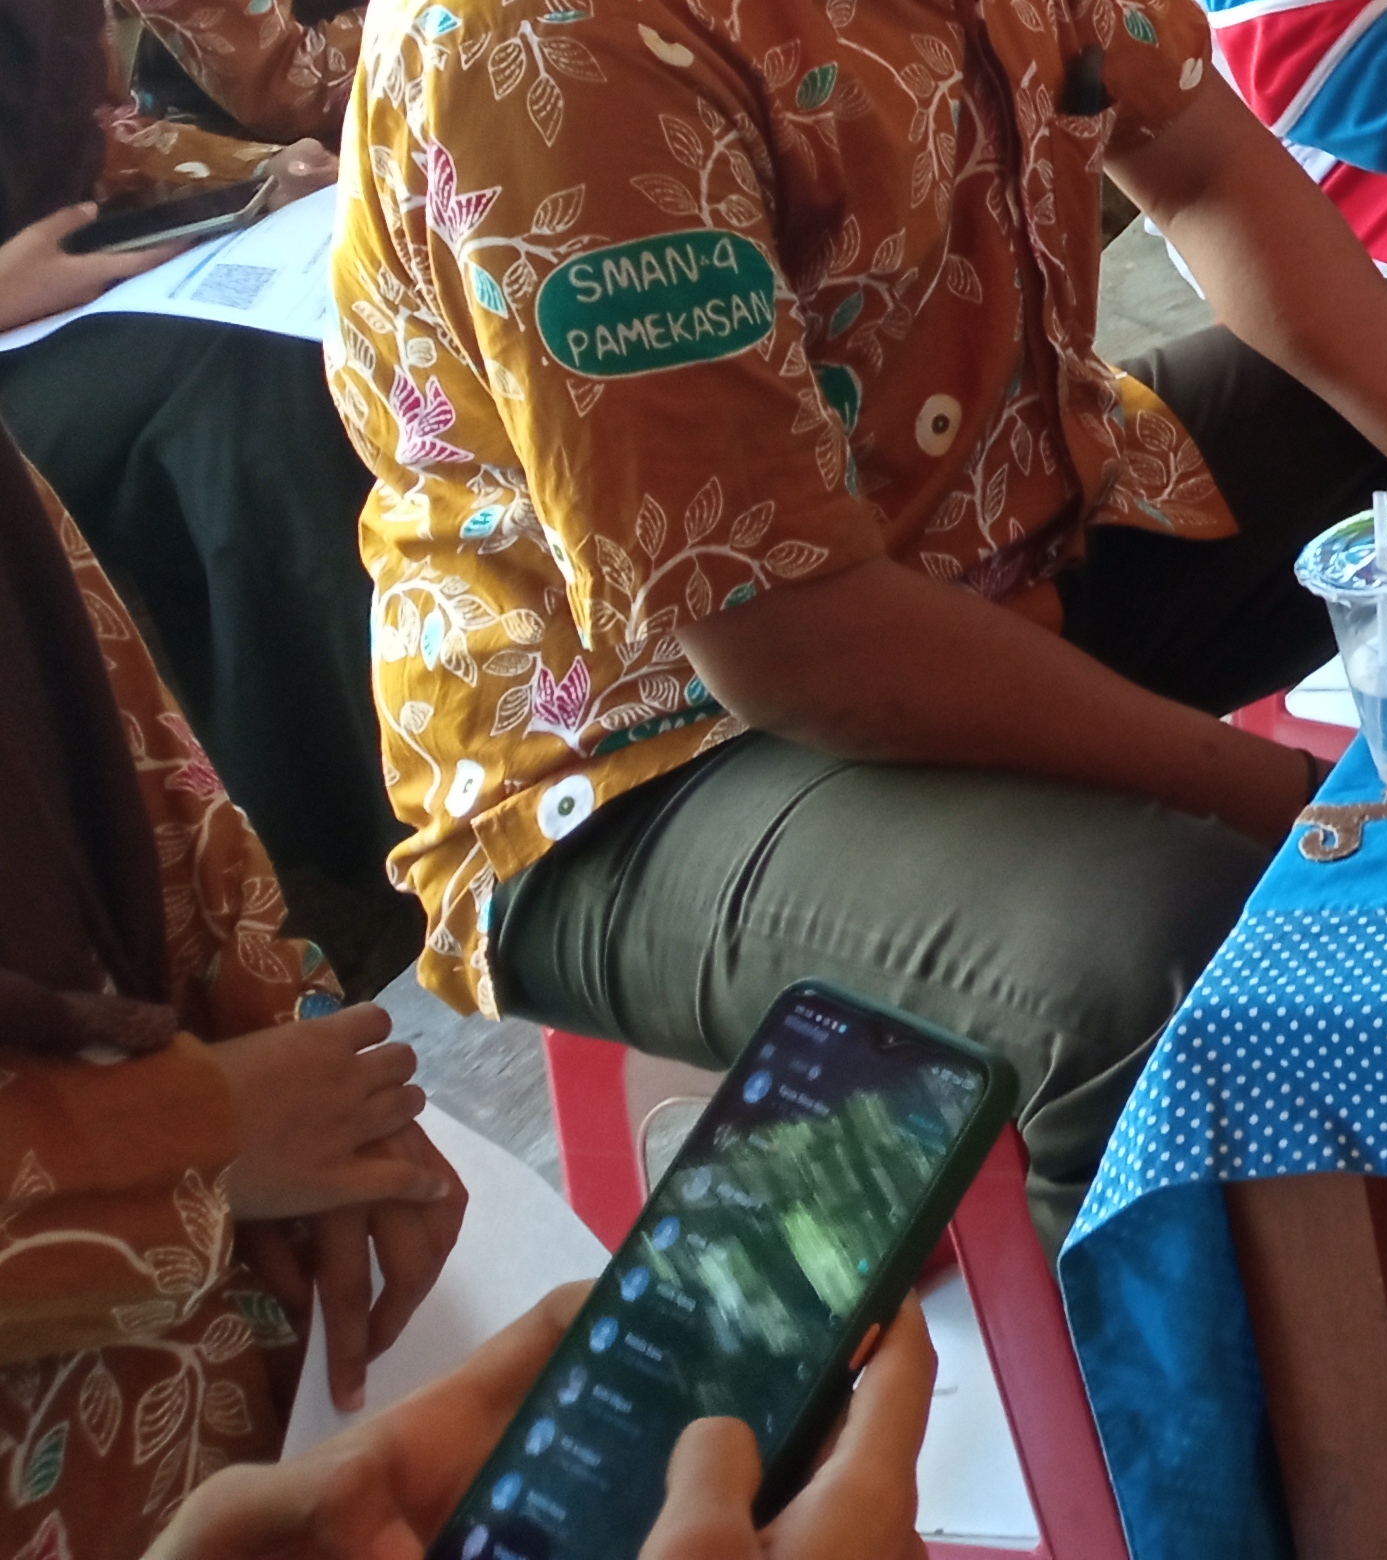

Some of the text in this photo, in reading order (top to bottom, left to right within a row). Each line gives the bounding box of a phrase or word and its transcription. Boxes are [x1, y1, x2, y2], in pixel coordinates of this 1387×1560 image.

[568, 236, 740, 304] SMAN 4
[565, 289, 773, 368] PAMEKASAN
